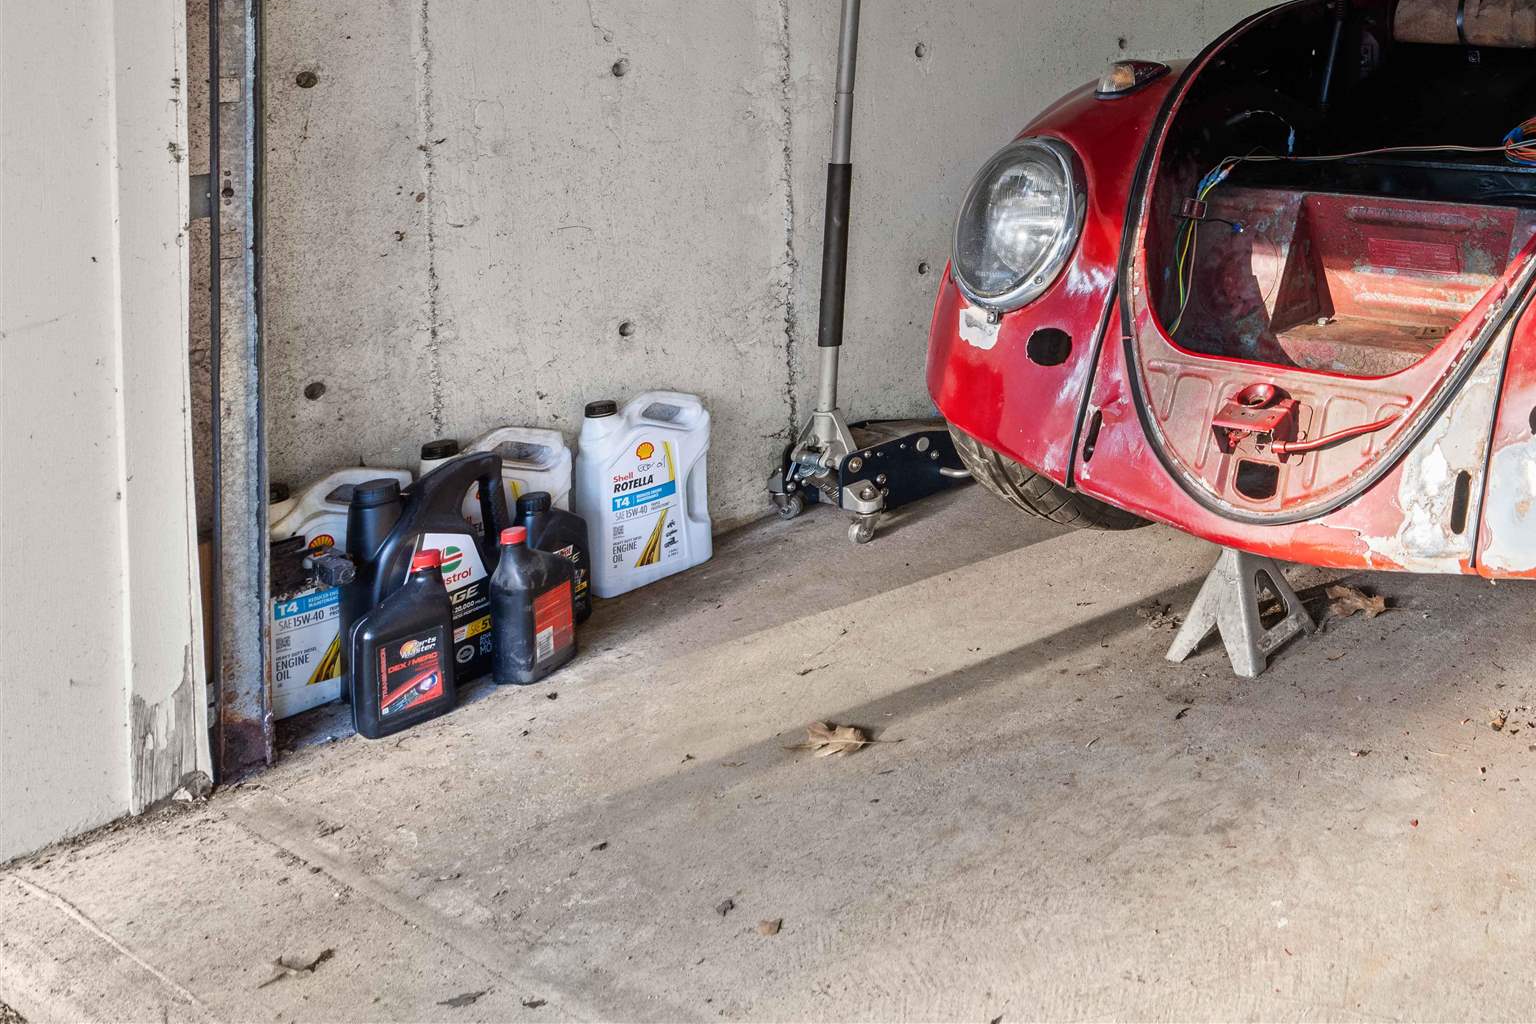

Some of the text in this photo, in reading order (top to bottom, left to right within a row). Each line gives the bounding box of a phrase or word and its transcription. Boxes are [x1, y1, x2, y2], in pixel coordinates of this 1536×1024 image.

[613, 472, 634, 483] Shell
[613, 474, 655, 494] ROTELLA
[614, 497, 631, 509] T4
[615, 505, 648, 521] SAE 15W-40
[613, 541, 638, 554] ENGINE
[613, 554, 623, 563] OIL
[444, 568, 472, 585] strol
[278, 601, 299, 617] T4
[278, 621, 294, 631] SAE
[293, 610, 325, 626] 15W-40
[275, 654, 310, 672] ENGINE
[276, 670, 291, 682] OIL
